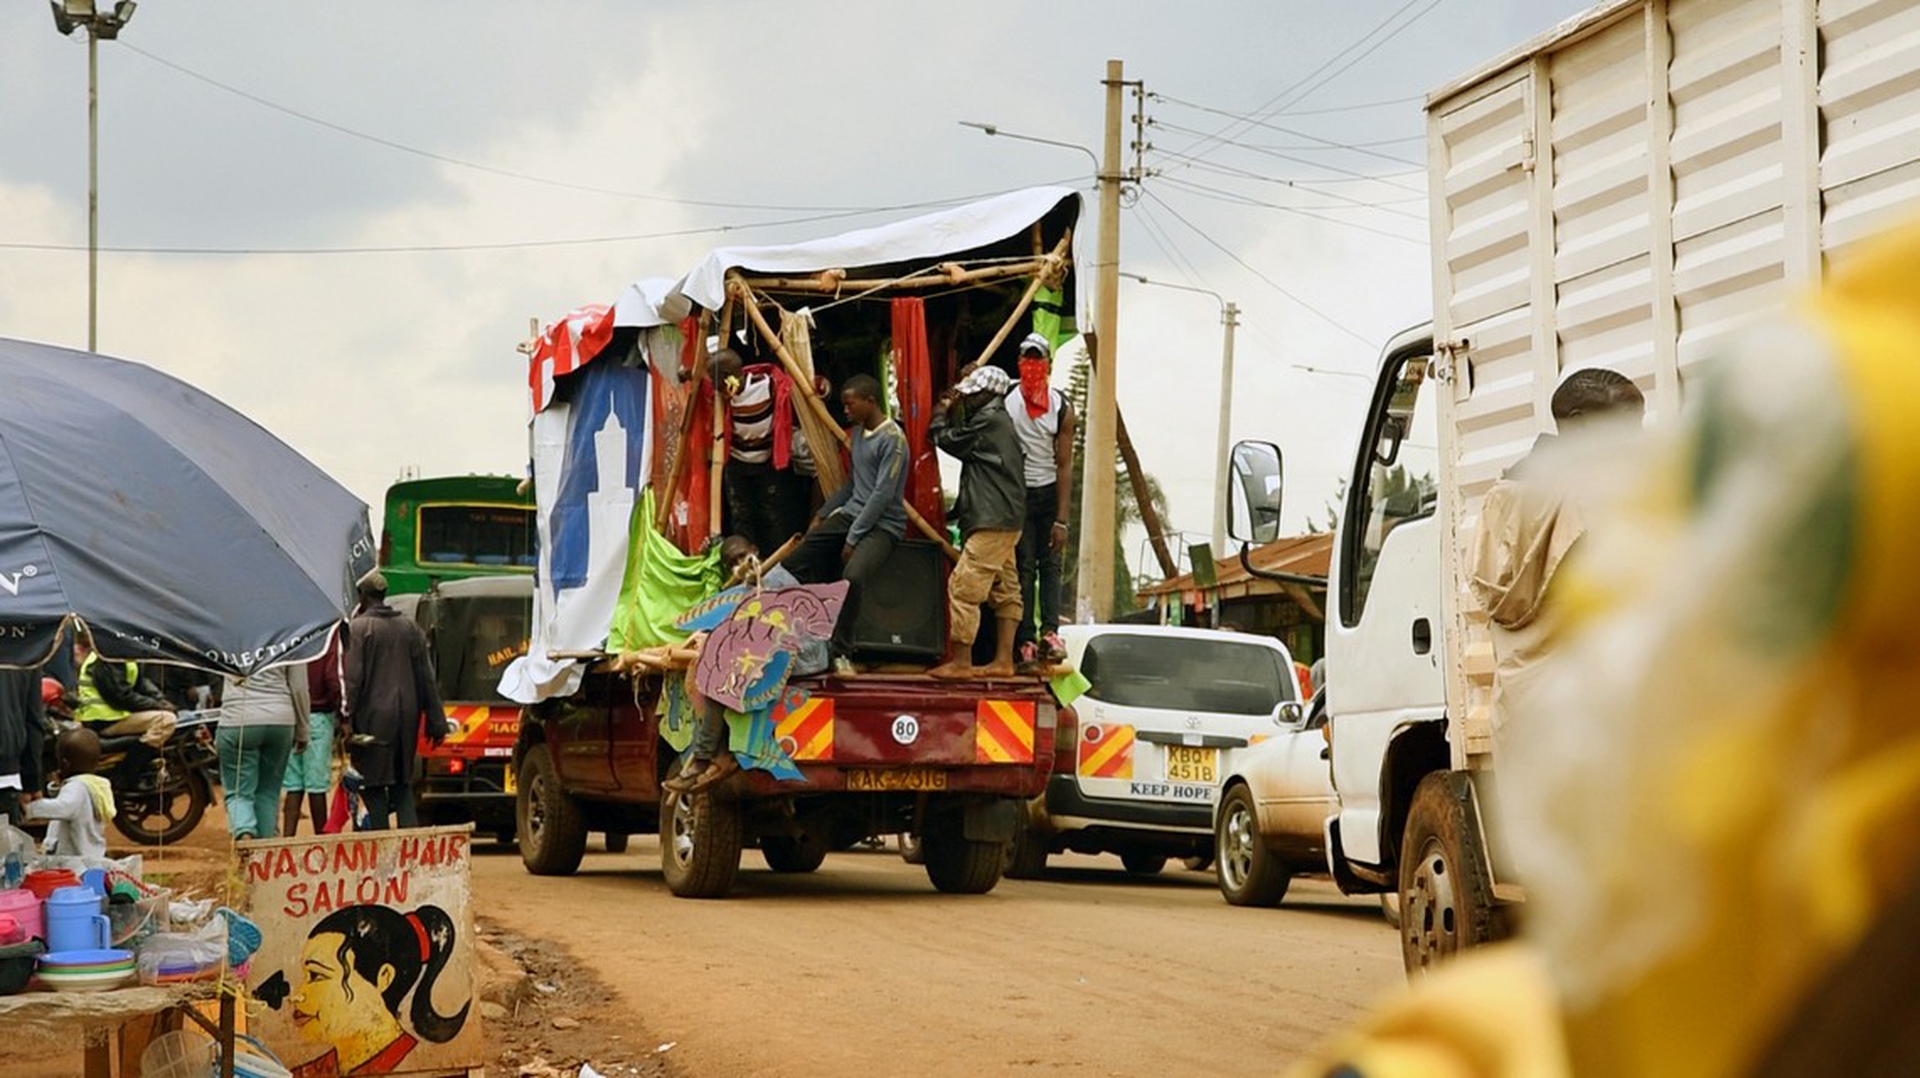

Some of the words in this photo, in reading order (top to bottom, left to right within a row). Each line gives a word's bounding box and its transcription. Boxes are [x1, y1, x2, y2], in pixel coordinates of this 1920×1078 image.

[487, 646, 517, 667] HAIL
[895, 720, 915, 736] 80
[1168, 746, 1202, 764] KBQ
[1169, 764, 1213, 781] 451B
[1130, 782, 1169, 797] KEEP
[1173, 785, 1213, 799] HOPE
[248, 840, 378, 884] NAOMI
[400, 835, 468, 869] HAIR
[284, 871, 409, 918] SALON
